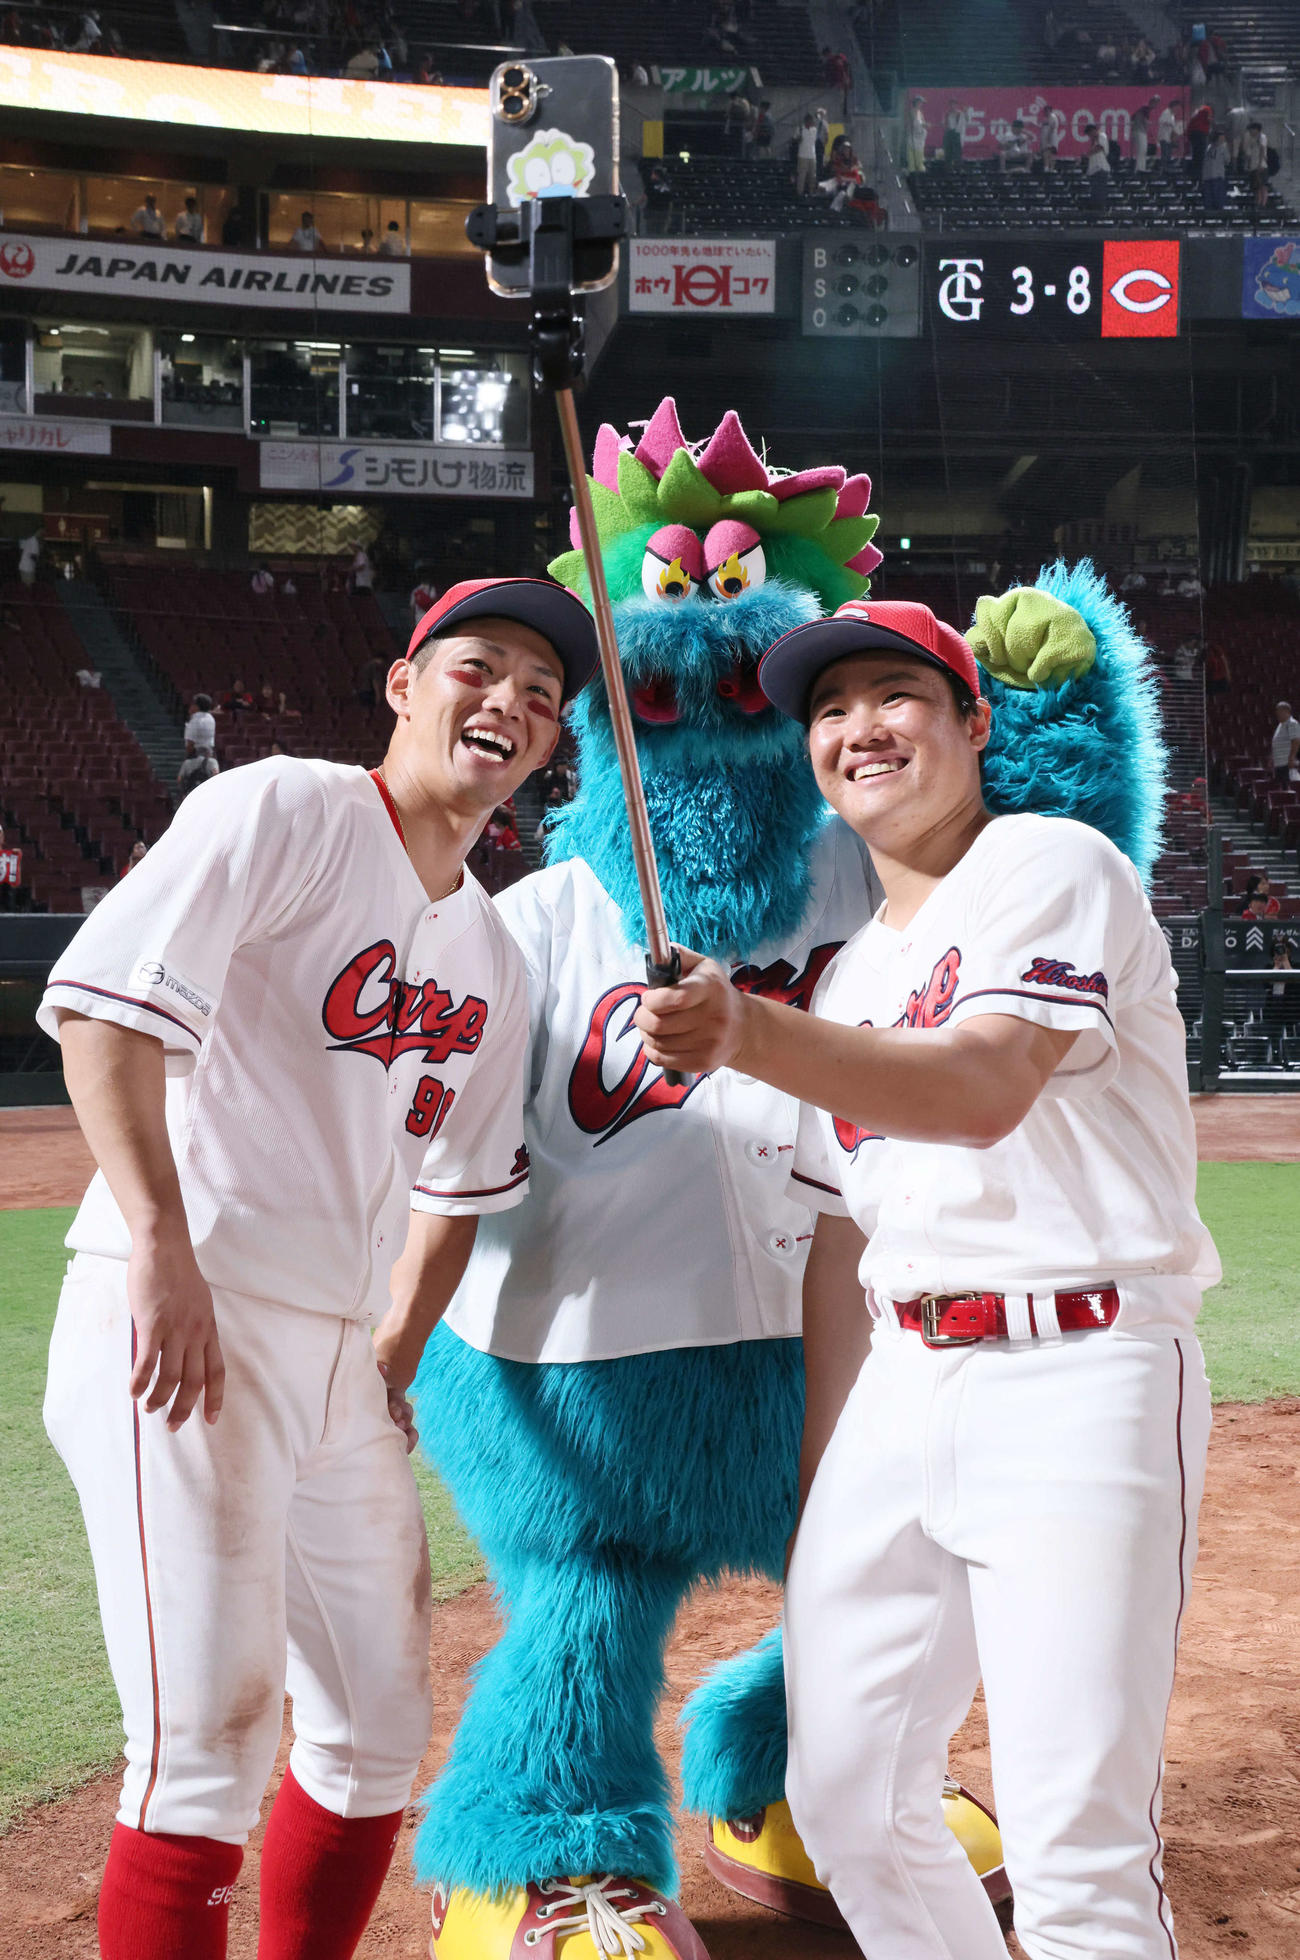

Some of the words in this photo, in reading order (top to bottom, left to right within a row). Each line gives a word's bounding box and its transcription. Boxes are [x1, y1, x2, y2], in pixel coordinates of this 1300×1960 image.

[813, 248, 827, 268] B
[56, 254, 192, 284] JAPAN
[200, 267, 394, 297] AIRLINES
[814, 278, 826, 298] S
[364, 456, 527, 492] シモハナ物流
